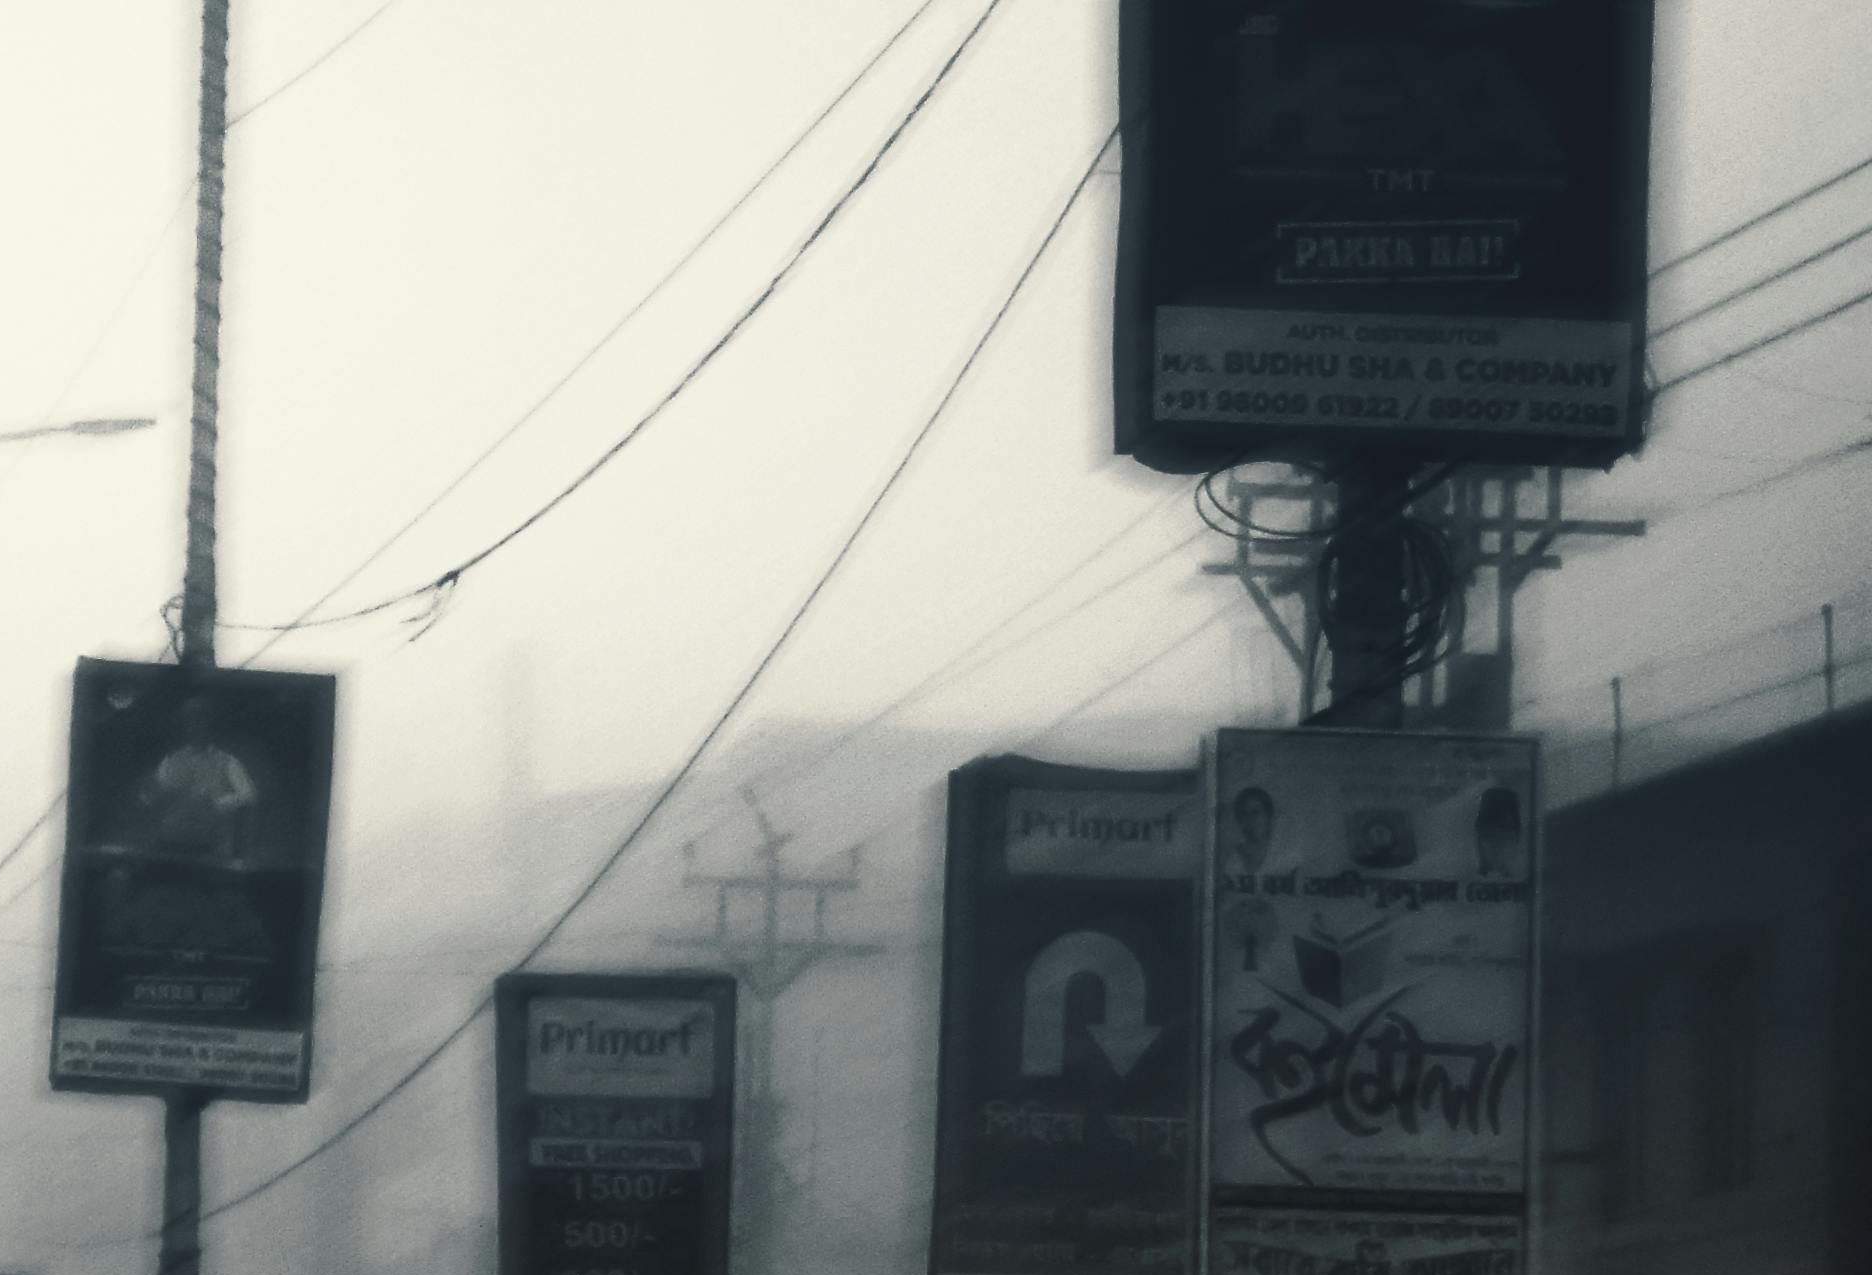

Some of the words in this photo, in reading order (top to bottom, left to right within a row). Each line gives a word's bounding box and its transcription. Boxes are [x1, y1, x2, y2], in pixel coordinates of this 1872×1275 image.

[1365, 165, 1438, 194] TMT
[1293, 235, 1416, 270] PAKKA
[1285, 323, 1351, 343] AUTH.
[1354, 325, 1500, 347] DISTRIBUTOR
[1223, 351, 1341, 379] BUDHU
[1347, 354, 1415, 382] SHA
[1423, 356, 1447, 383] &
[1454, 357, 1619, 389] COMPANY
[1161, 389, 1209, 411] +91
[1021, 806, 1179, 847] Primart
[540, 1019, 696, 1062] Primart
[568, 1173, 685, 1202] 1500/-
[563, 1219, 658, 1249] 500/-
